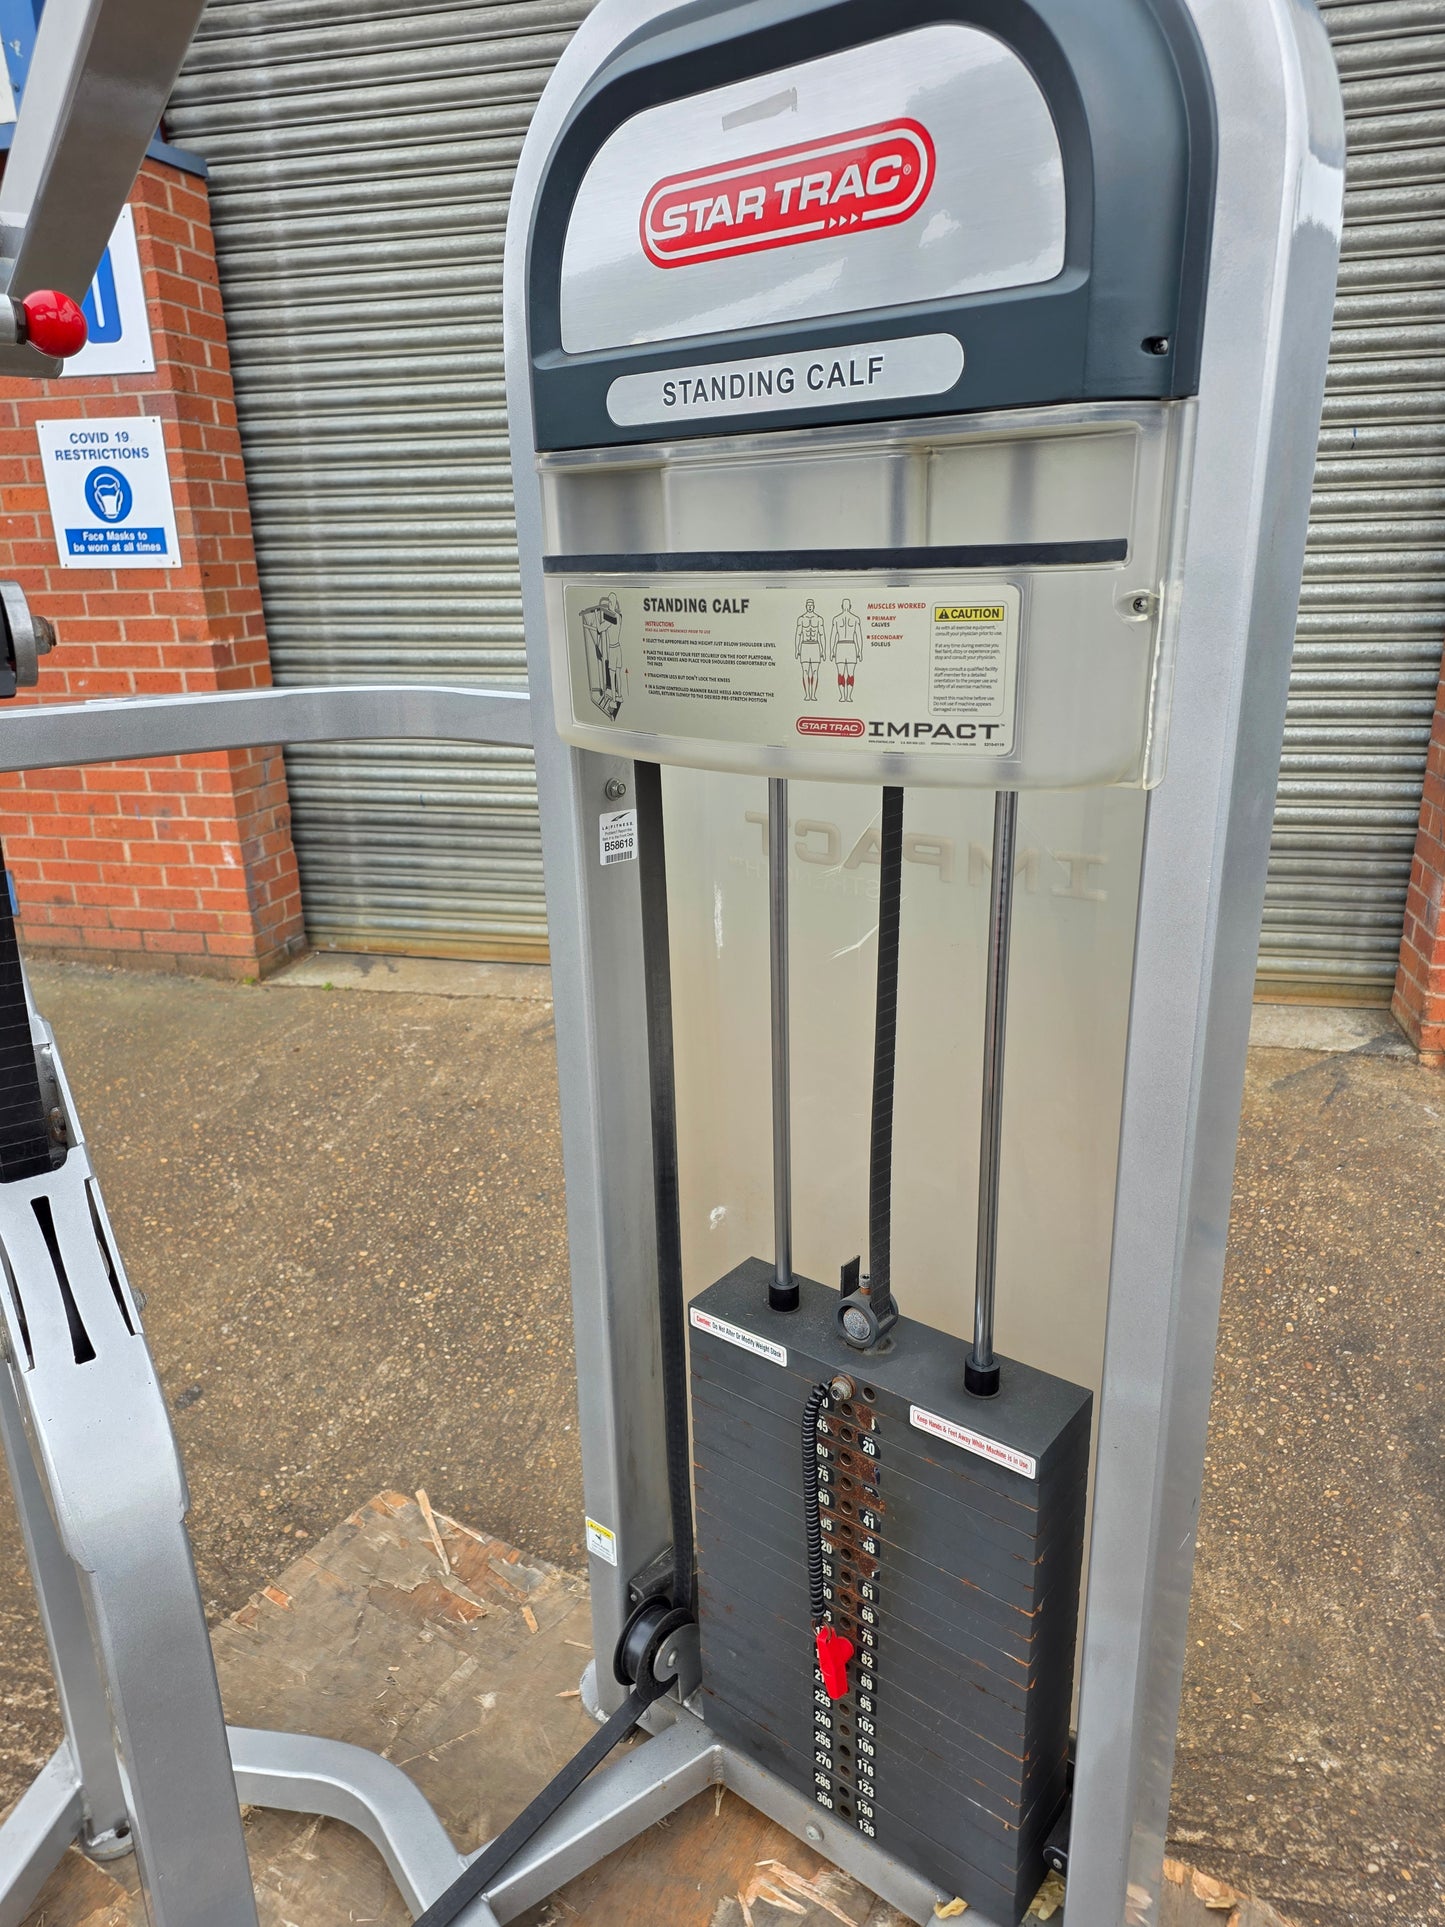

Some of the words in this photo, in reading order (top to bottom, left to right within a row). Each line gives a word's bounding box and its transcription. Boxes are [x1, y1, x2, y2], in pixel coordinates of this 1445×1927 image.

[651, 185, 766, 241] STAR
[774, 154, 903, 214] TRAC
[662, 367, 795, 407] STANDING
[806, 356, 885, 390] CALF
[69, 432, 109, 444] COVID
[114, 431, 129, 443] 19
[55, 447, 149, 460] RESTRICTIONS
[82, 531, 103, 541] Face
[106, 531, 135, 541] Masks
[138, 531, 148, 540] to
[73, 542, 84, 552] be
[87, 544, 109, 552] worn
[111, 542, 120, 551] at
[124, 542, 134, 551] all
[136, 542, 161, 551] times
[643, 598, 707, 613] STANDING
[712, 599, 750, 614] CALF
[950, 608, 1000, 618] CAUTION
[800, 722, 827, 730] STAR
[828, 723, 860, 732] TRAC
[868, 722, 999, 740] IMPACT
[604, 838, 634, 851] B58618
[817, 1419, 828, 1433] 45
[917, 1415, 928, 1425] Keep
[929, 1419, 942, 1431] Hands
[948, 1428, 957, 1438] Feet
[958, 1433, 971, 1444] Away
[972, 1438, 985, 1450] While
[986, 1444, 1006, 1460] Machine
[863, 1440, 875, 1455] 20
[817, 1467, 829, 1482] 75
[818, 1491, 830, 1505] 90
[863, 1515, 874, 1529] 41
[863, 1540, 875, 1554] 48
[862, 1586, 873, 1600] 61
[862, 1608, 874, 1623] 68
[861, 1630, 873, 1646] 75
[861, 1653, 873, 1668] 82
[815, 1669, 824, 1683] 21
[860, 1675, 872, 1690] 89
[815, 1690, 831, 1708] 225
[860, 1697, 871, 1712] 95
[815, 1711, 831, 1728] 240
[858, 1718, 874, 1736] 102
[815, 1731, 831, 1749] 255
[857, 1739, 874, 1756] 109
[816, 1752, 832, 1769] 270
[857, 1760, 874, 1777] 116
[815, 1772, 831, 1790] 285
[858, 1780, 874, 1798] 123
[817, 1792, 832, 1809] 300
[857, 1801, 873, 1818] 130
[858, 1820, 874, 1837] 136
